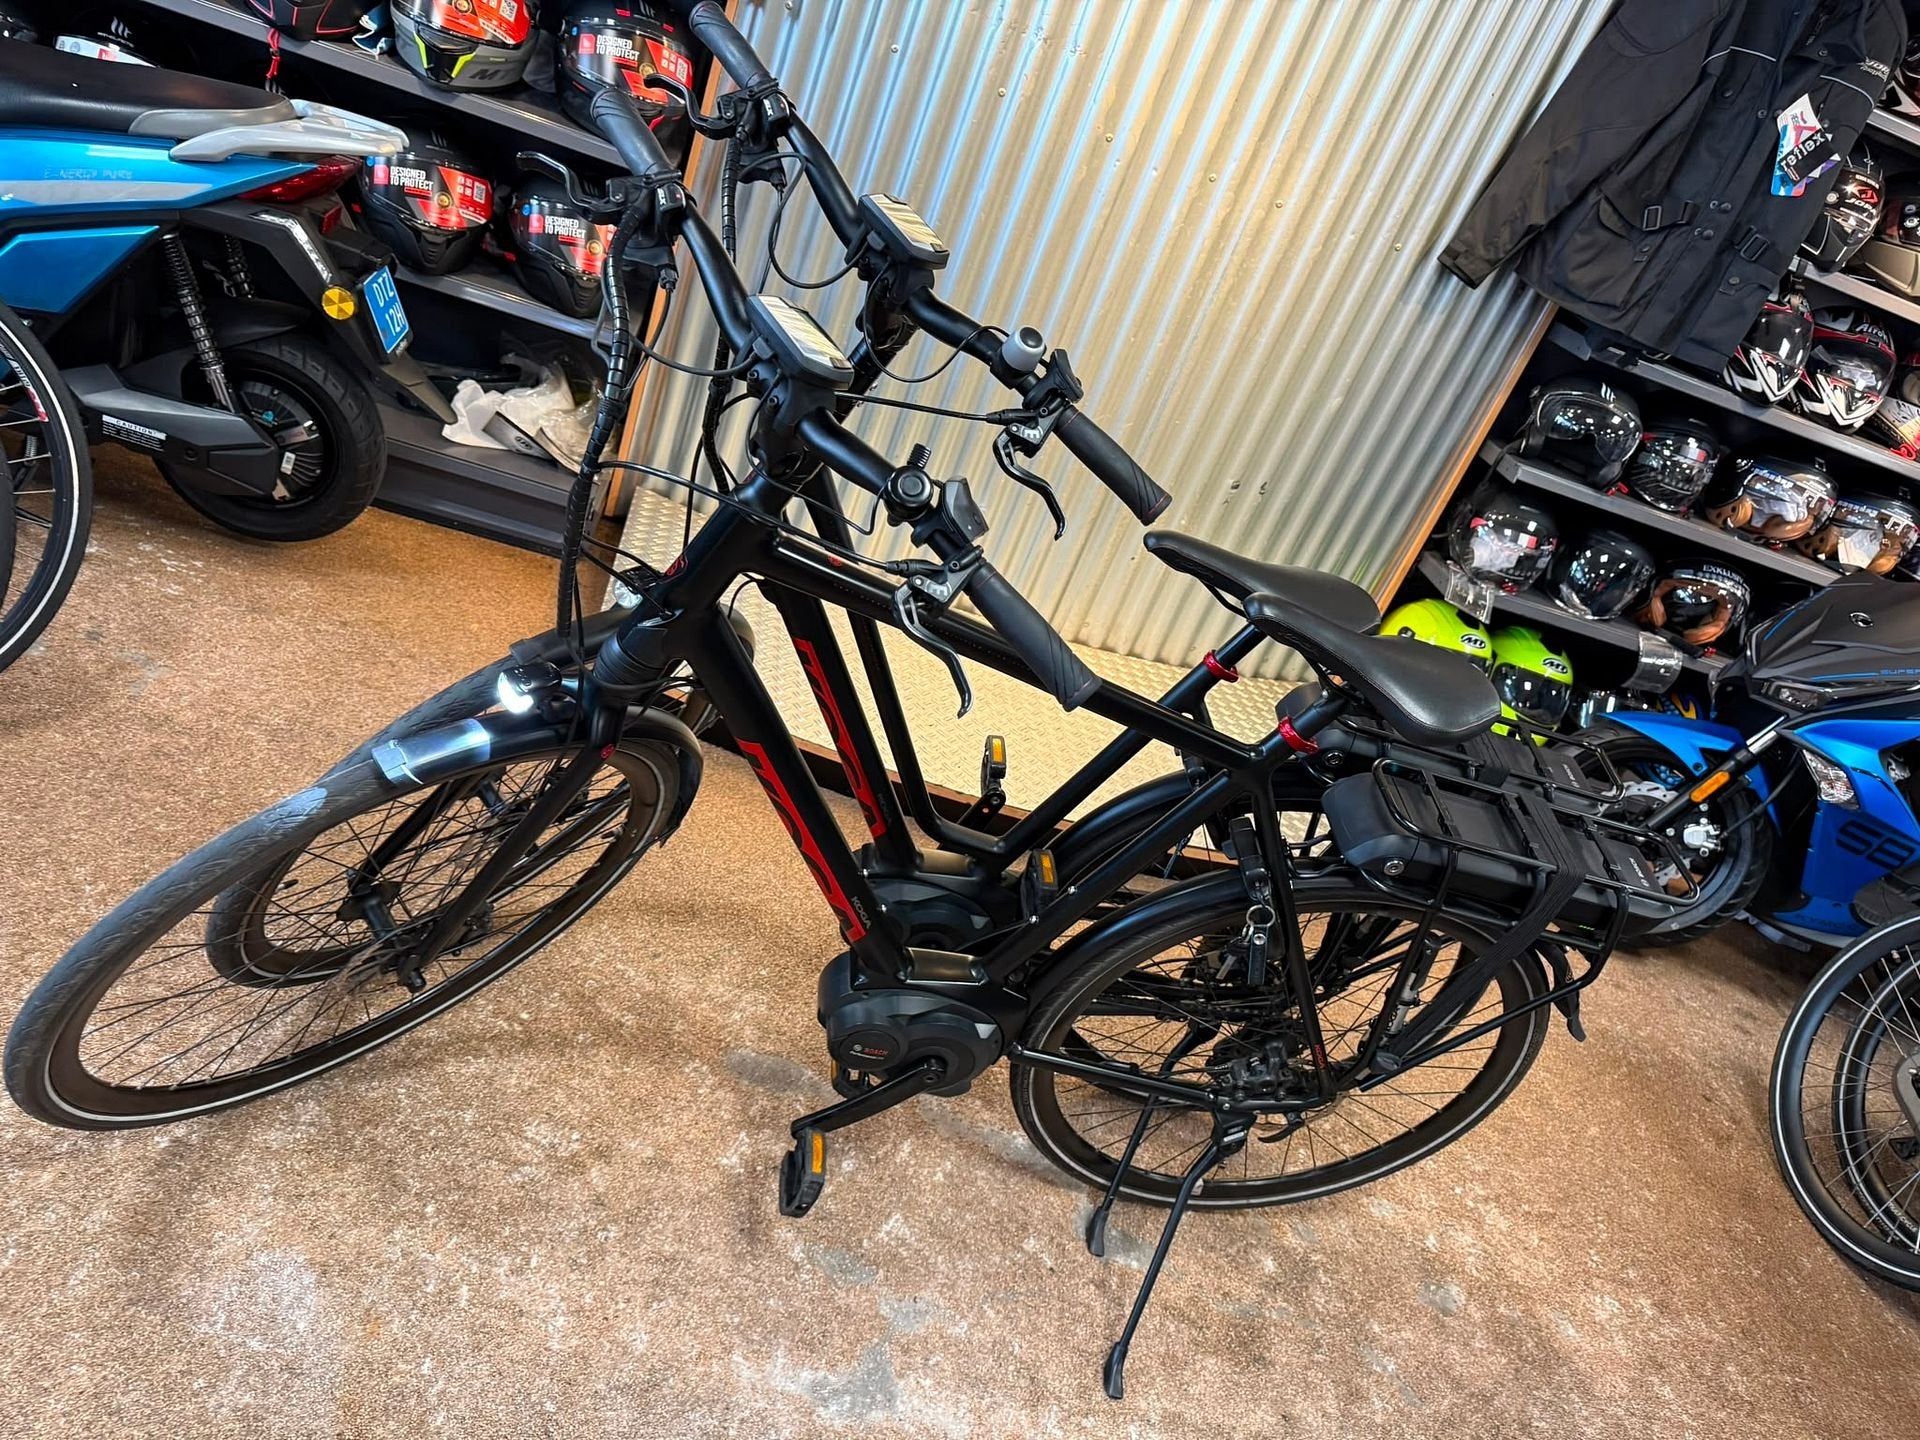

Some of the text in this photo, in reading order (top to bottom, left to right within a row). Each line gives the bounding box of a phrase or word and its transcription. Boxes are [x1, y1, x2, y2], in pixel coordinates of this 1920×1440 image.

[597, 34, 633, 50] DESIGNED
[596, 44, 640, 61] TO PROTECT
[1780, 131, 1826, 172] reflex
[390, 165, 427, 180] DESIGNED
[390, 175, 434, 191] TO PROTECT
[544, 215, 579, 229] DESIGNED
[545, 224, 586, 239] TO PROTECT
[372, 272, 394, 308] DTZ
[851, 895, 872, 930] KOGA
